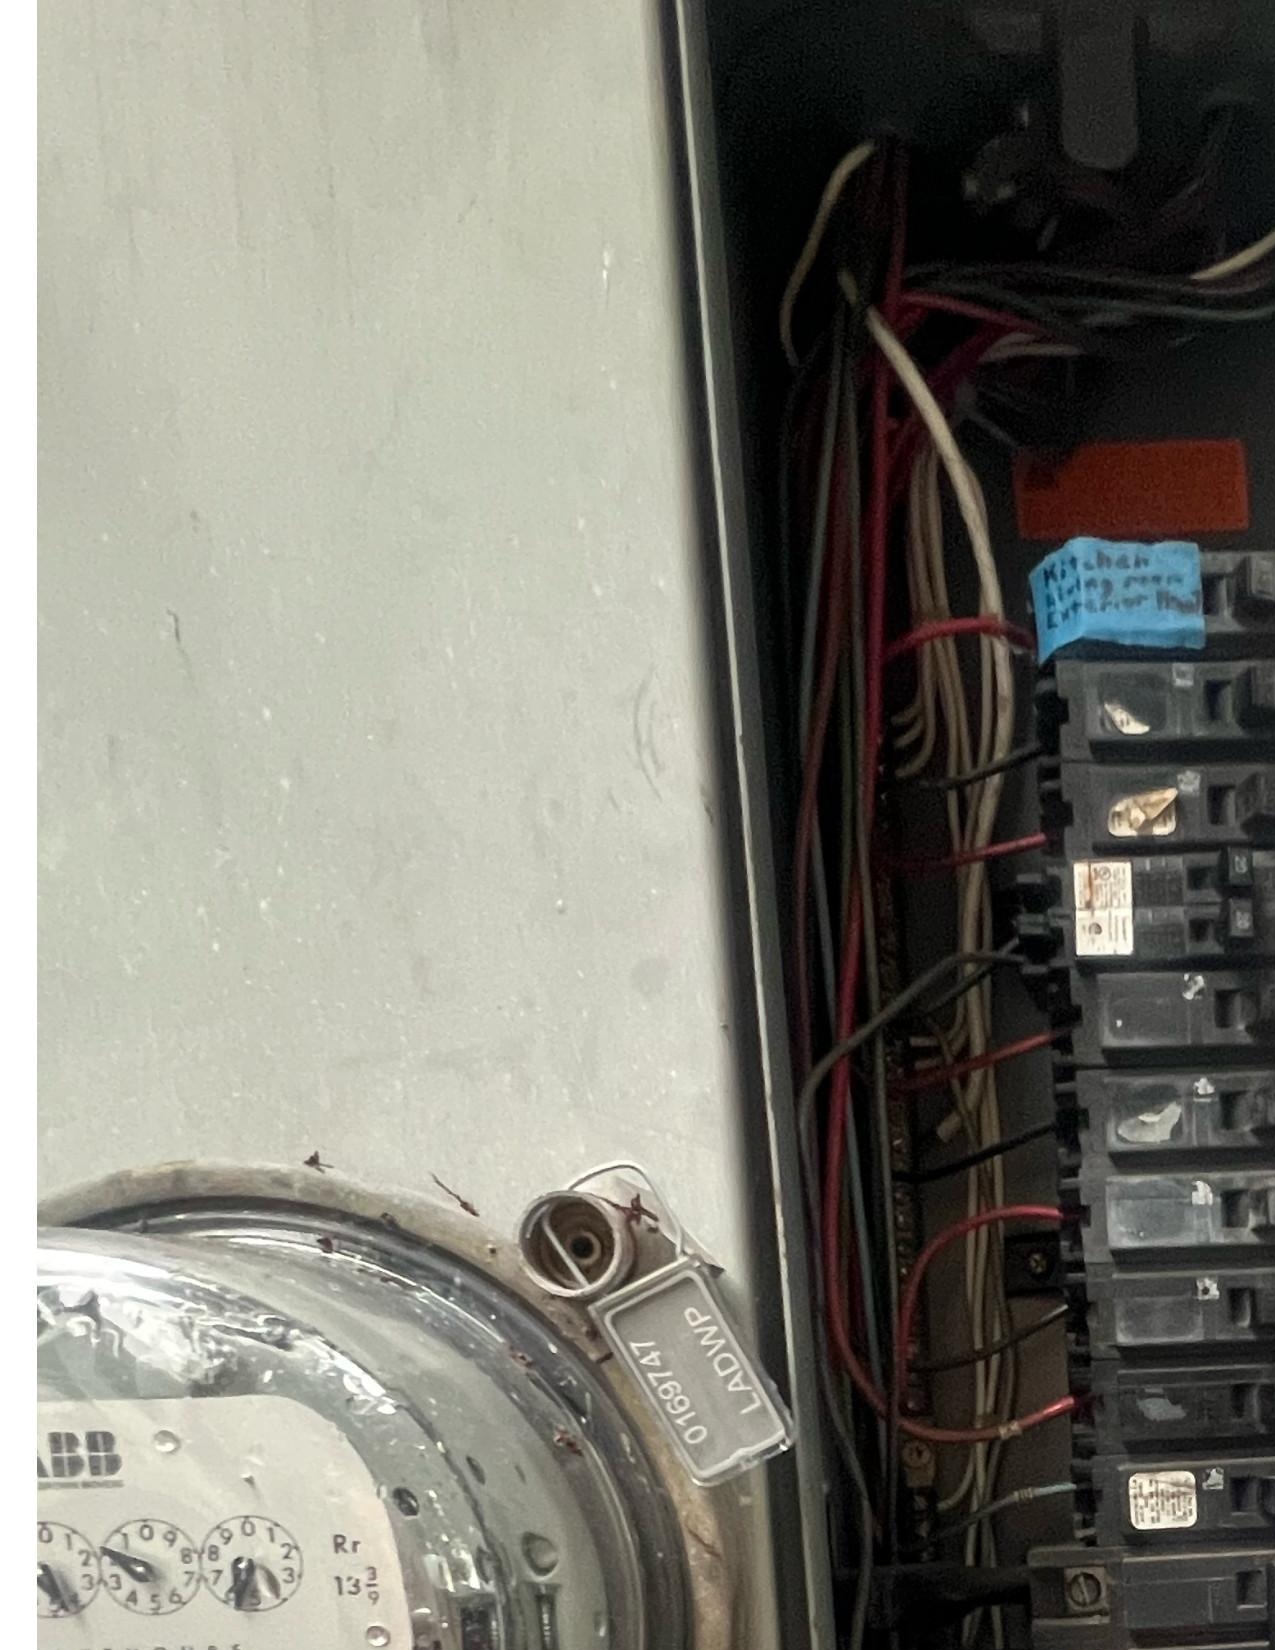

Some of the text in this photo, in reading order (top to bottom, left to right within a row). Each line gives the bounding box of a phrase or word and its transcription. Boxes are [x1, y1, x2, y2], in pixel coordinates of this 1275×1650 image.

[629, 1341, 708, 1444] 0169747
[684, 1307, 762, 1415] LADWP
[37, 1431, 122, 1477] BB
[333, 1534, 361, 1554] Rr
